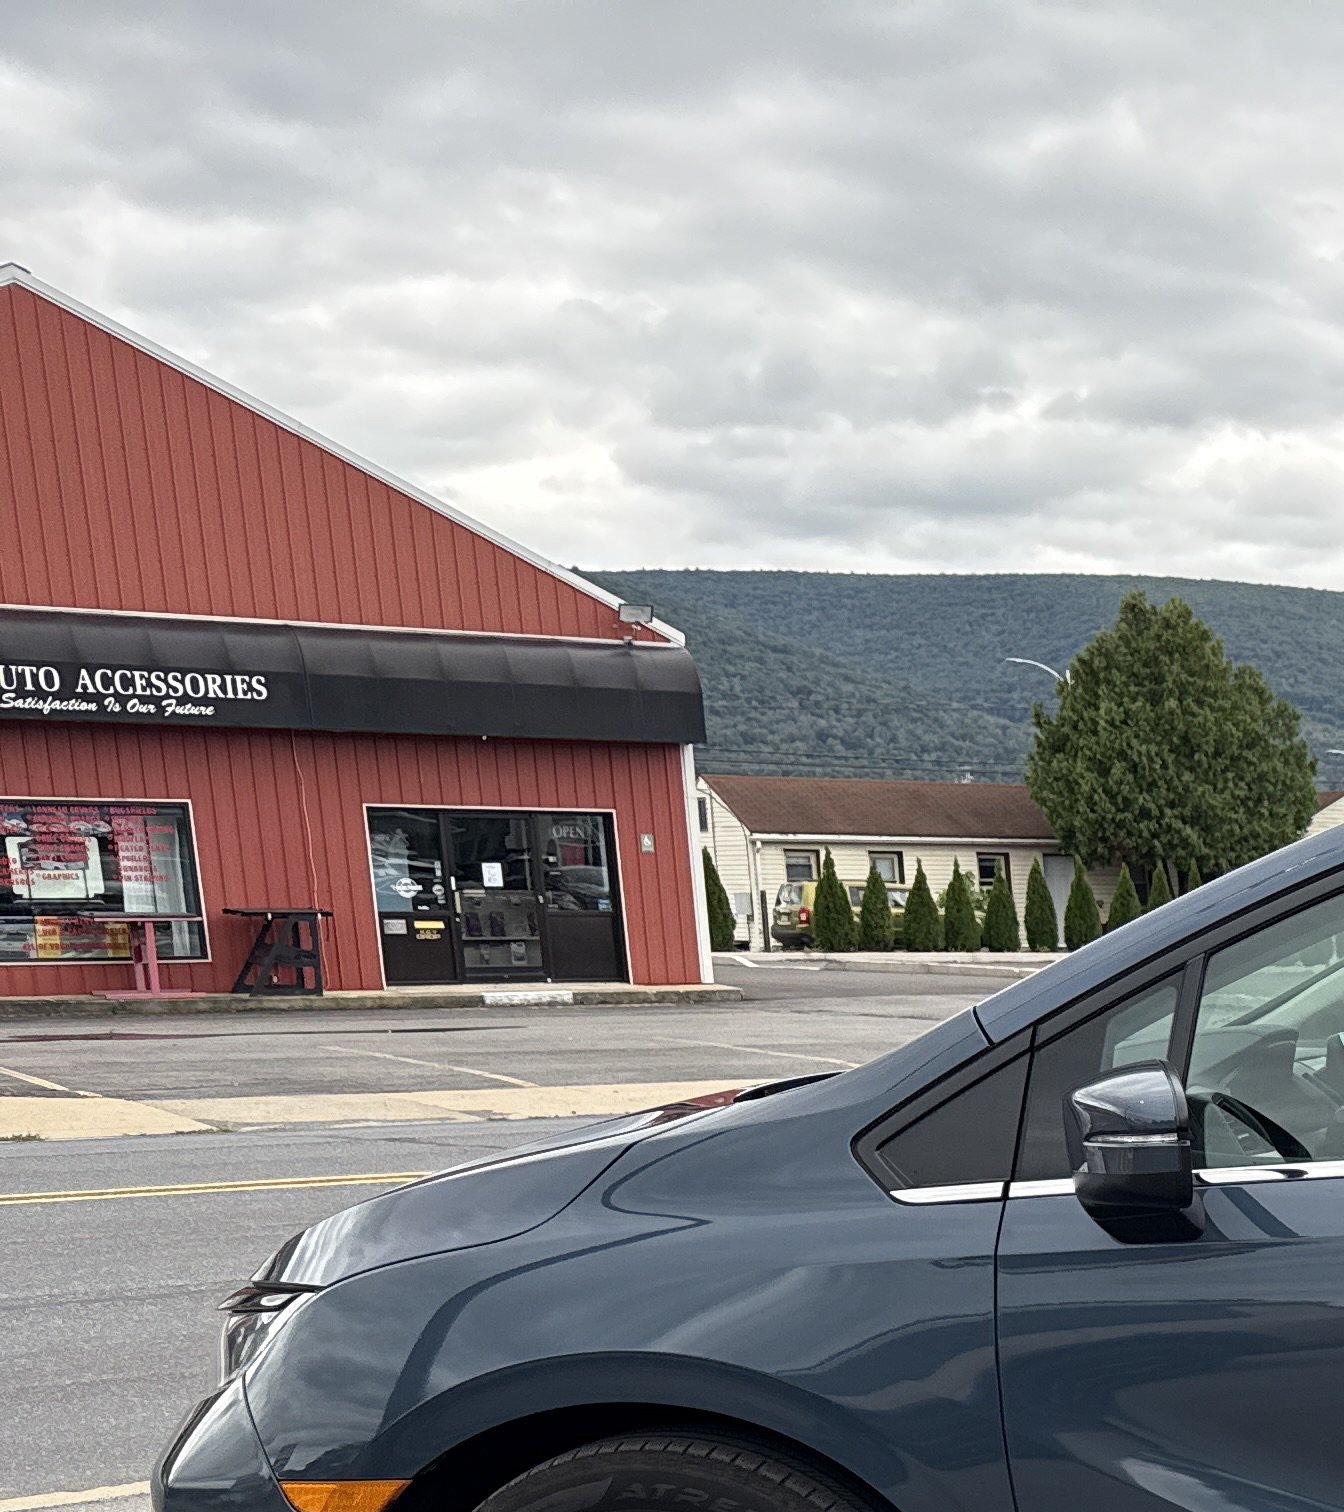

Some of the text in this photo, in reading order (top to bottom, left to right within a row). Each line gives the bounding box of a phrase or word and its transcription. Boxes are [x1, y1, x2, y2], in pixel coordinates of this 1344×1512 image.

[75, 668, 268, 700] ACCESSORIES
[0, 693, 216, 717] Satisfaction Is Our Future
[552, 825, 585, 839] OPEN
[42, 872, 80, 881] GRAPHICS
